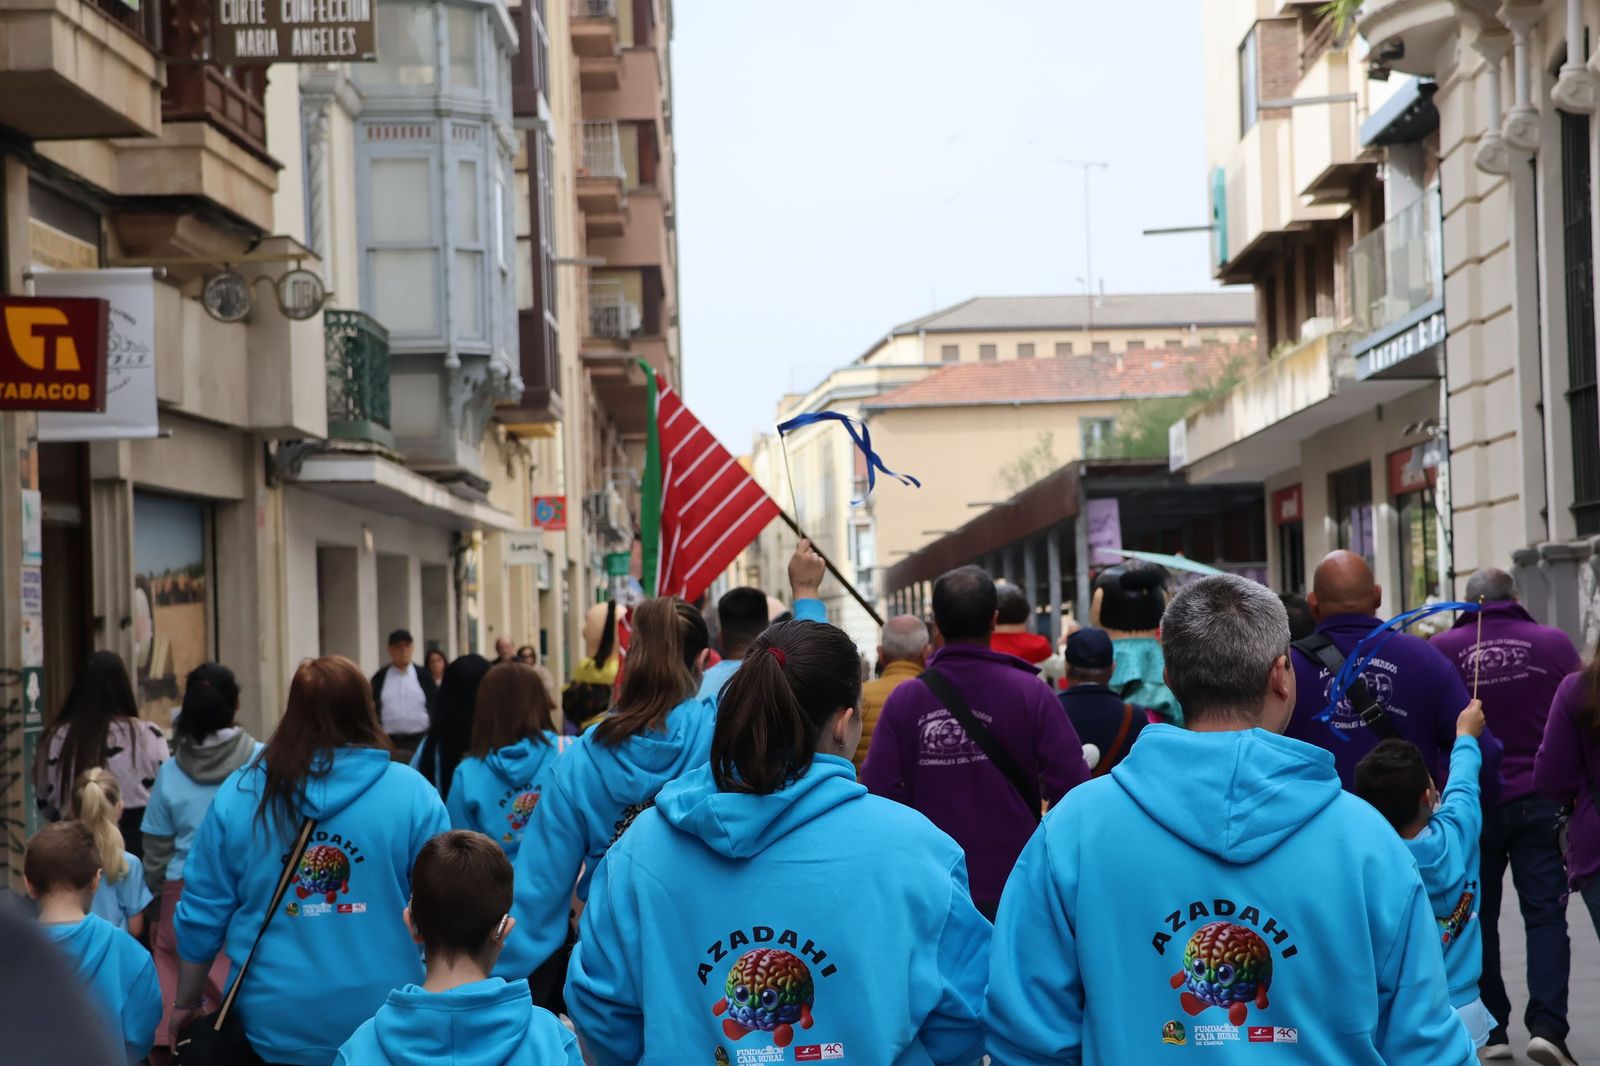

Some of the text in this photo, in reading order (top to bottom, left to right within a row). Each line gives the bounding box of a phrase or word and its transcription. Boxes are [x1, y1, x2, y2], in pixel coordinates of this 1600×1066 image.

[220, 0, 371, 24] CORTE CONFECCION
[235, 27, 357, 57] MARIA ANGELES
[1152, 899, 1298, 959] AZADAHI
[697, 926, 838, 986] AZADAHI
[1195, 1033, 1216, 1041] CAJA
[1217, 1032, 1241, 1041] RURAL
[737, 1054, 785, 1064] CAJA RURAL
